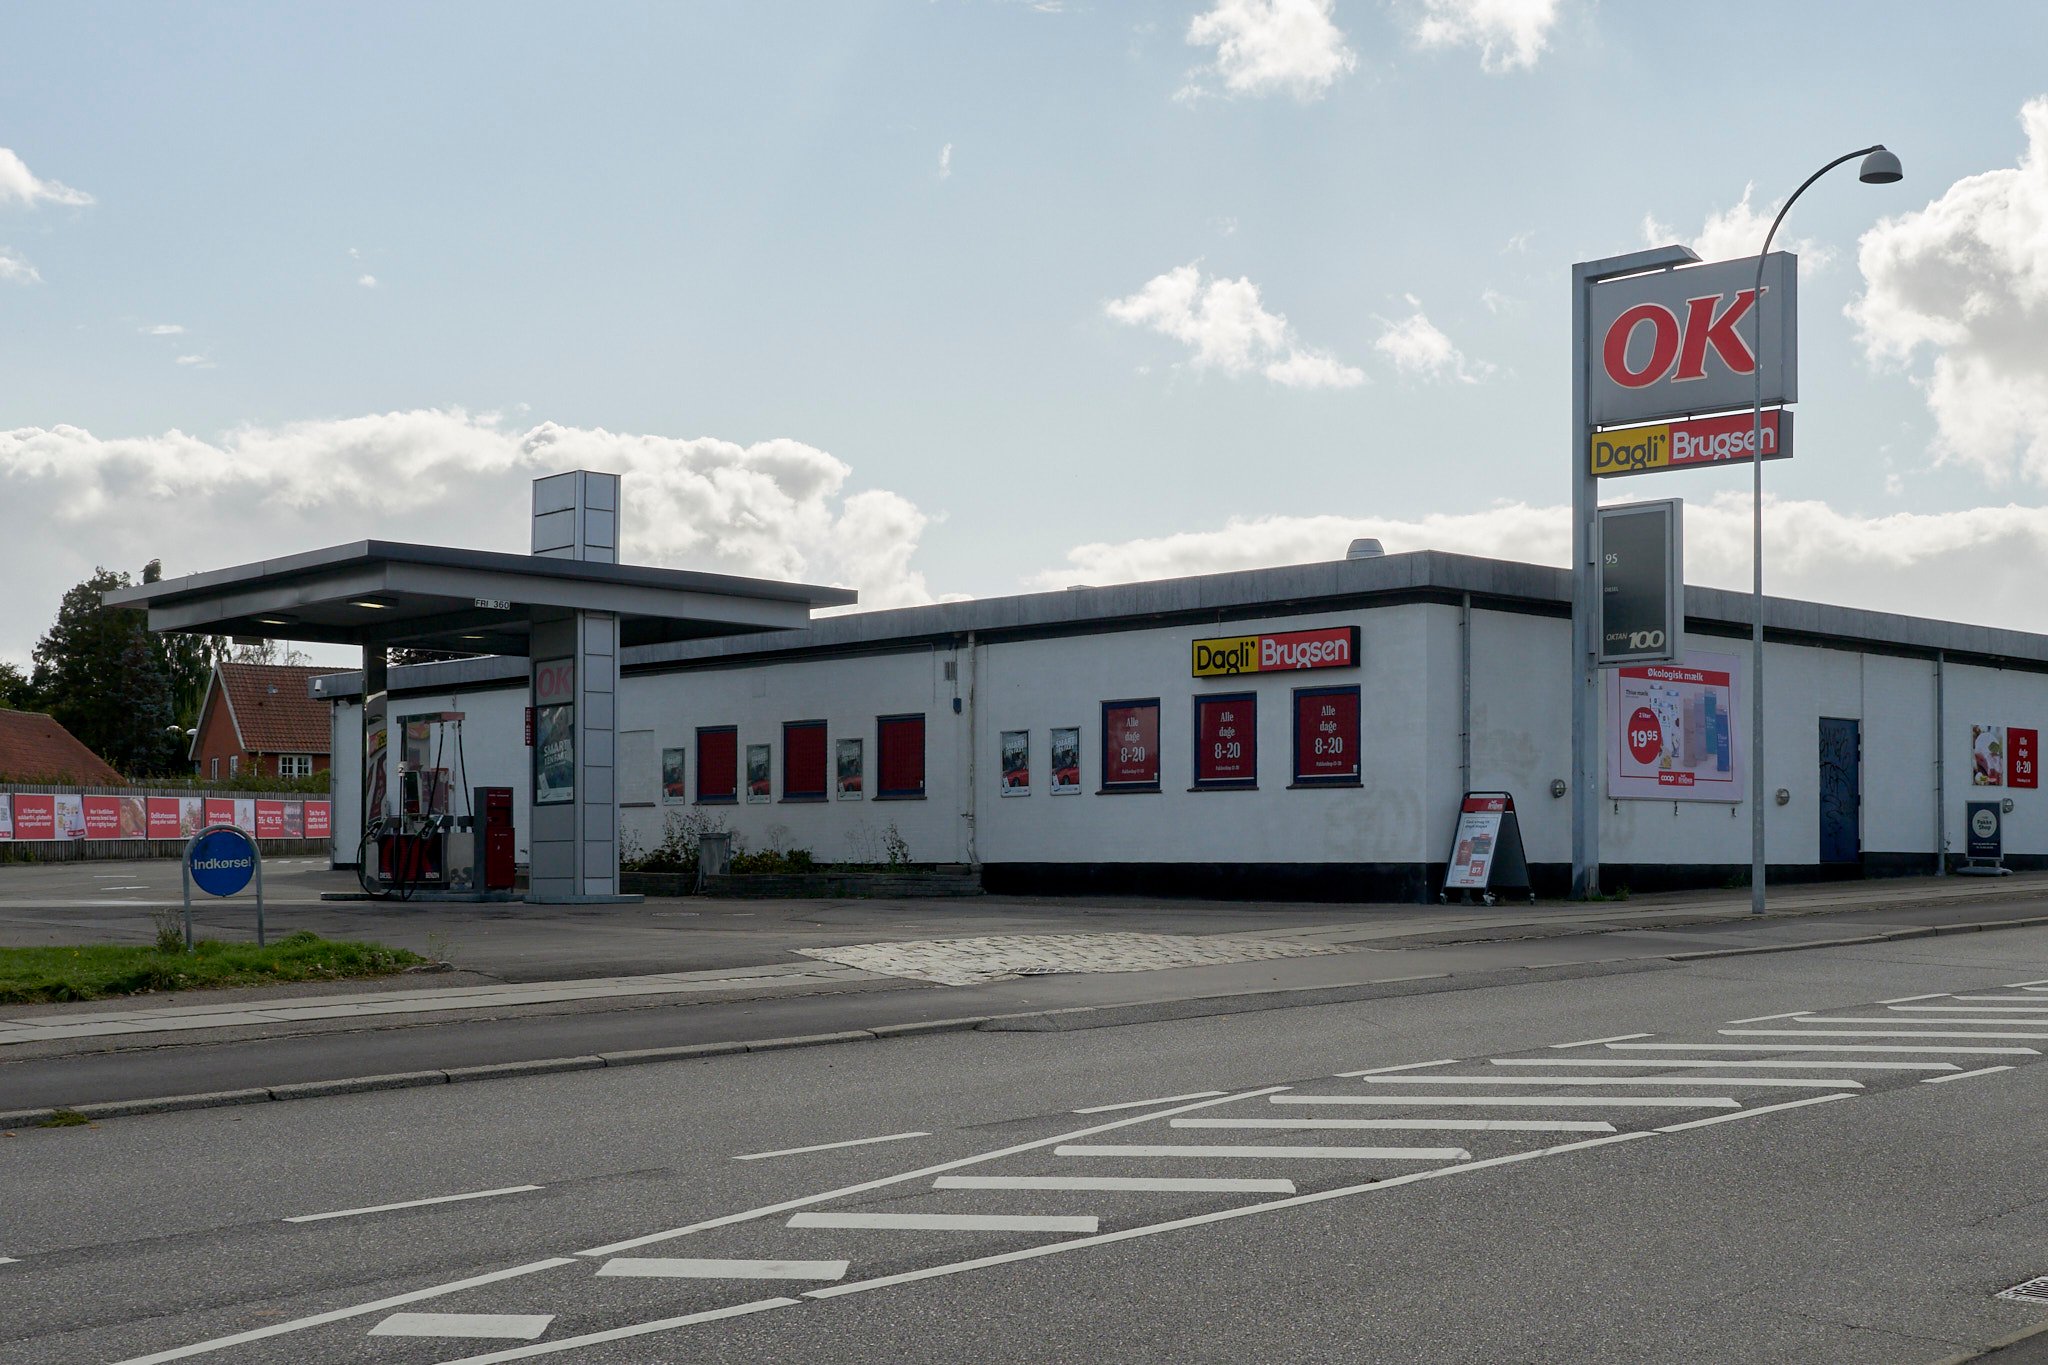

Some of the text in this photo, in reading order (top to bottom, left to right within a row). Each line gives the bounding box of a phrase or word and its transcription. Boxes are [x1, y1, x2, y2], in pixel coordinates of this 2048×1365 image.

[1603, 285, 1770, 389] OK
[1672, 426, 1774, 460] Brugsen
[1606, 553, 1618, 564] 95
[494, 601, 509, 609] 360
[1606, 630, 1664, 648] OKTAN 100
[1197, 638, 1348, 674] Dagli' Brugsen
[537, 666, 572, 697] OK
[1648, 668, 1703, 683] Økologisk mælk
[1220, 712, 1234, 722] Alle
[1321, 705, 1336, 716] Alle
[1126, 717, 1139, 727] Alle
[1320, 721, 1337, 733] dage
[1125, 731, 1140, 743] dage
[1219, 727, 1235, 739] dage
[1215, 742, 1240, 759] 8-20
[1315, 737, 1343, 754] 8-20
[1121, 747, 1145, 762] 8-20
[2016, 761, 2031, 773] 8-20
[194, 856, 251, 870] Indkørsel
